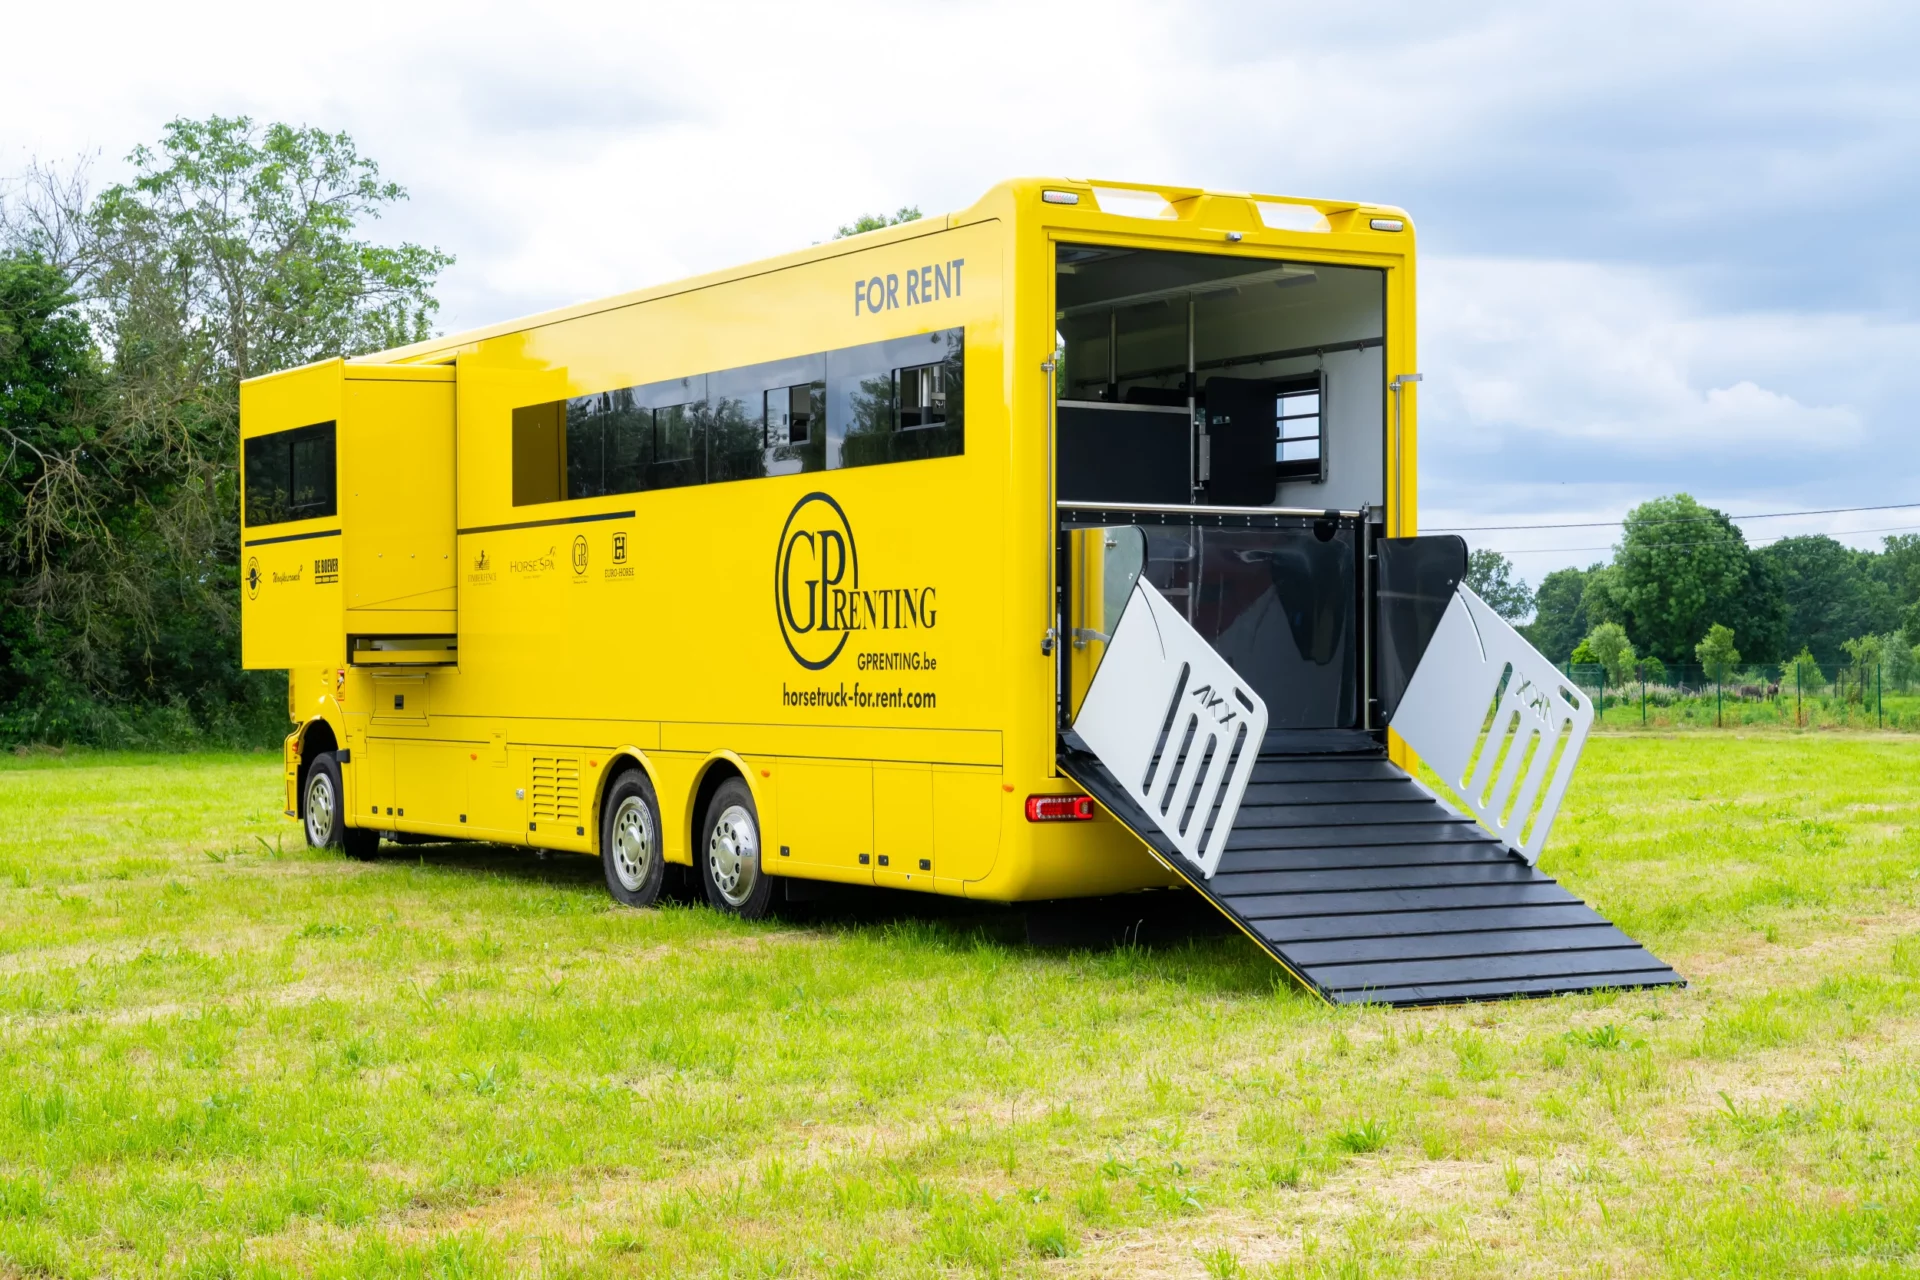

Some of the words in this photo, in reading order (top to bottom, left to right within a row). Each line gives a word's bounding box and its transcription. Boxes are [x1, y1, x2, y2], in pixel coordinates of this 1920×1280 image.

[855, 273, 900, 317] FOR
[906, 258, 965, 307] RENT
[510, 560, 538, 573] HORSE
[539, 558, 555, 571] SPA
[604, 567, 635, 578] EURO-HORSE
[857, 652, 937, 671] GPRENTING.be
[783, 682, 937, 708] horsetruck-for.rent.com
